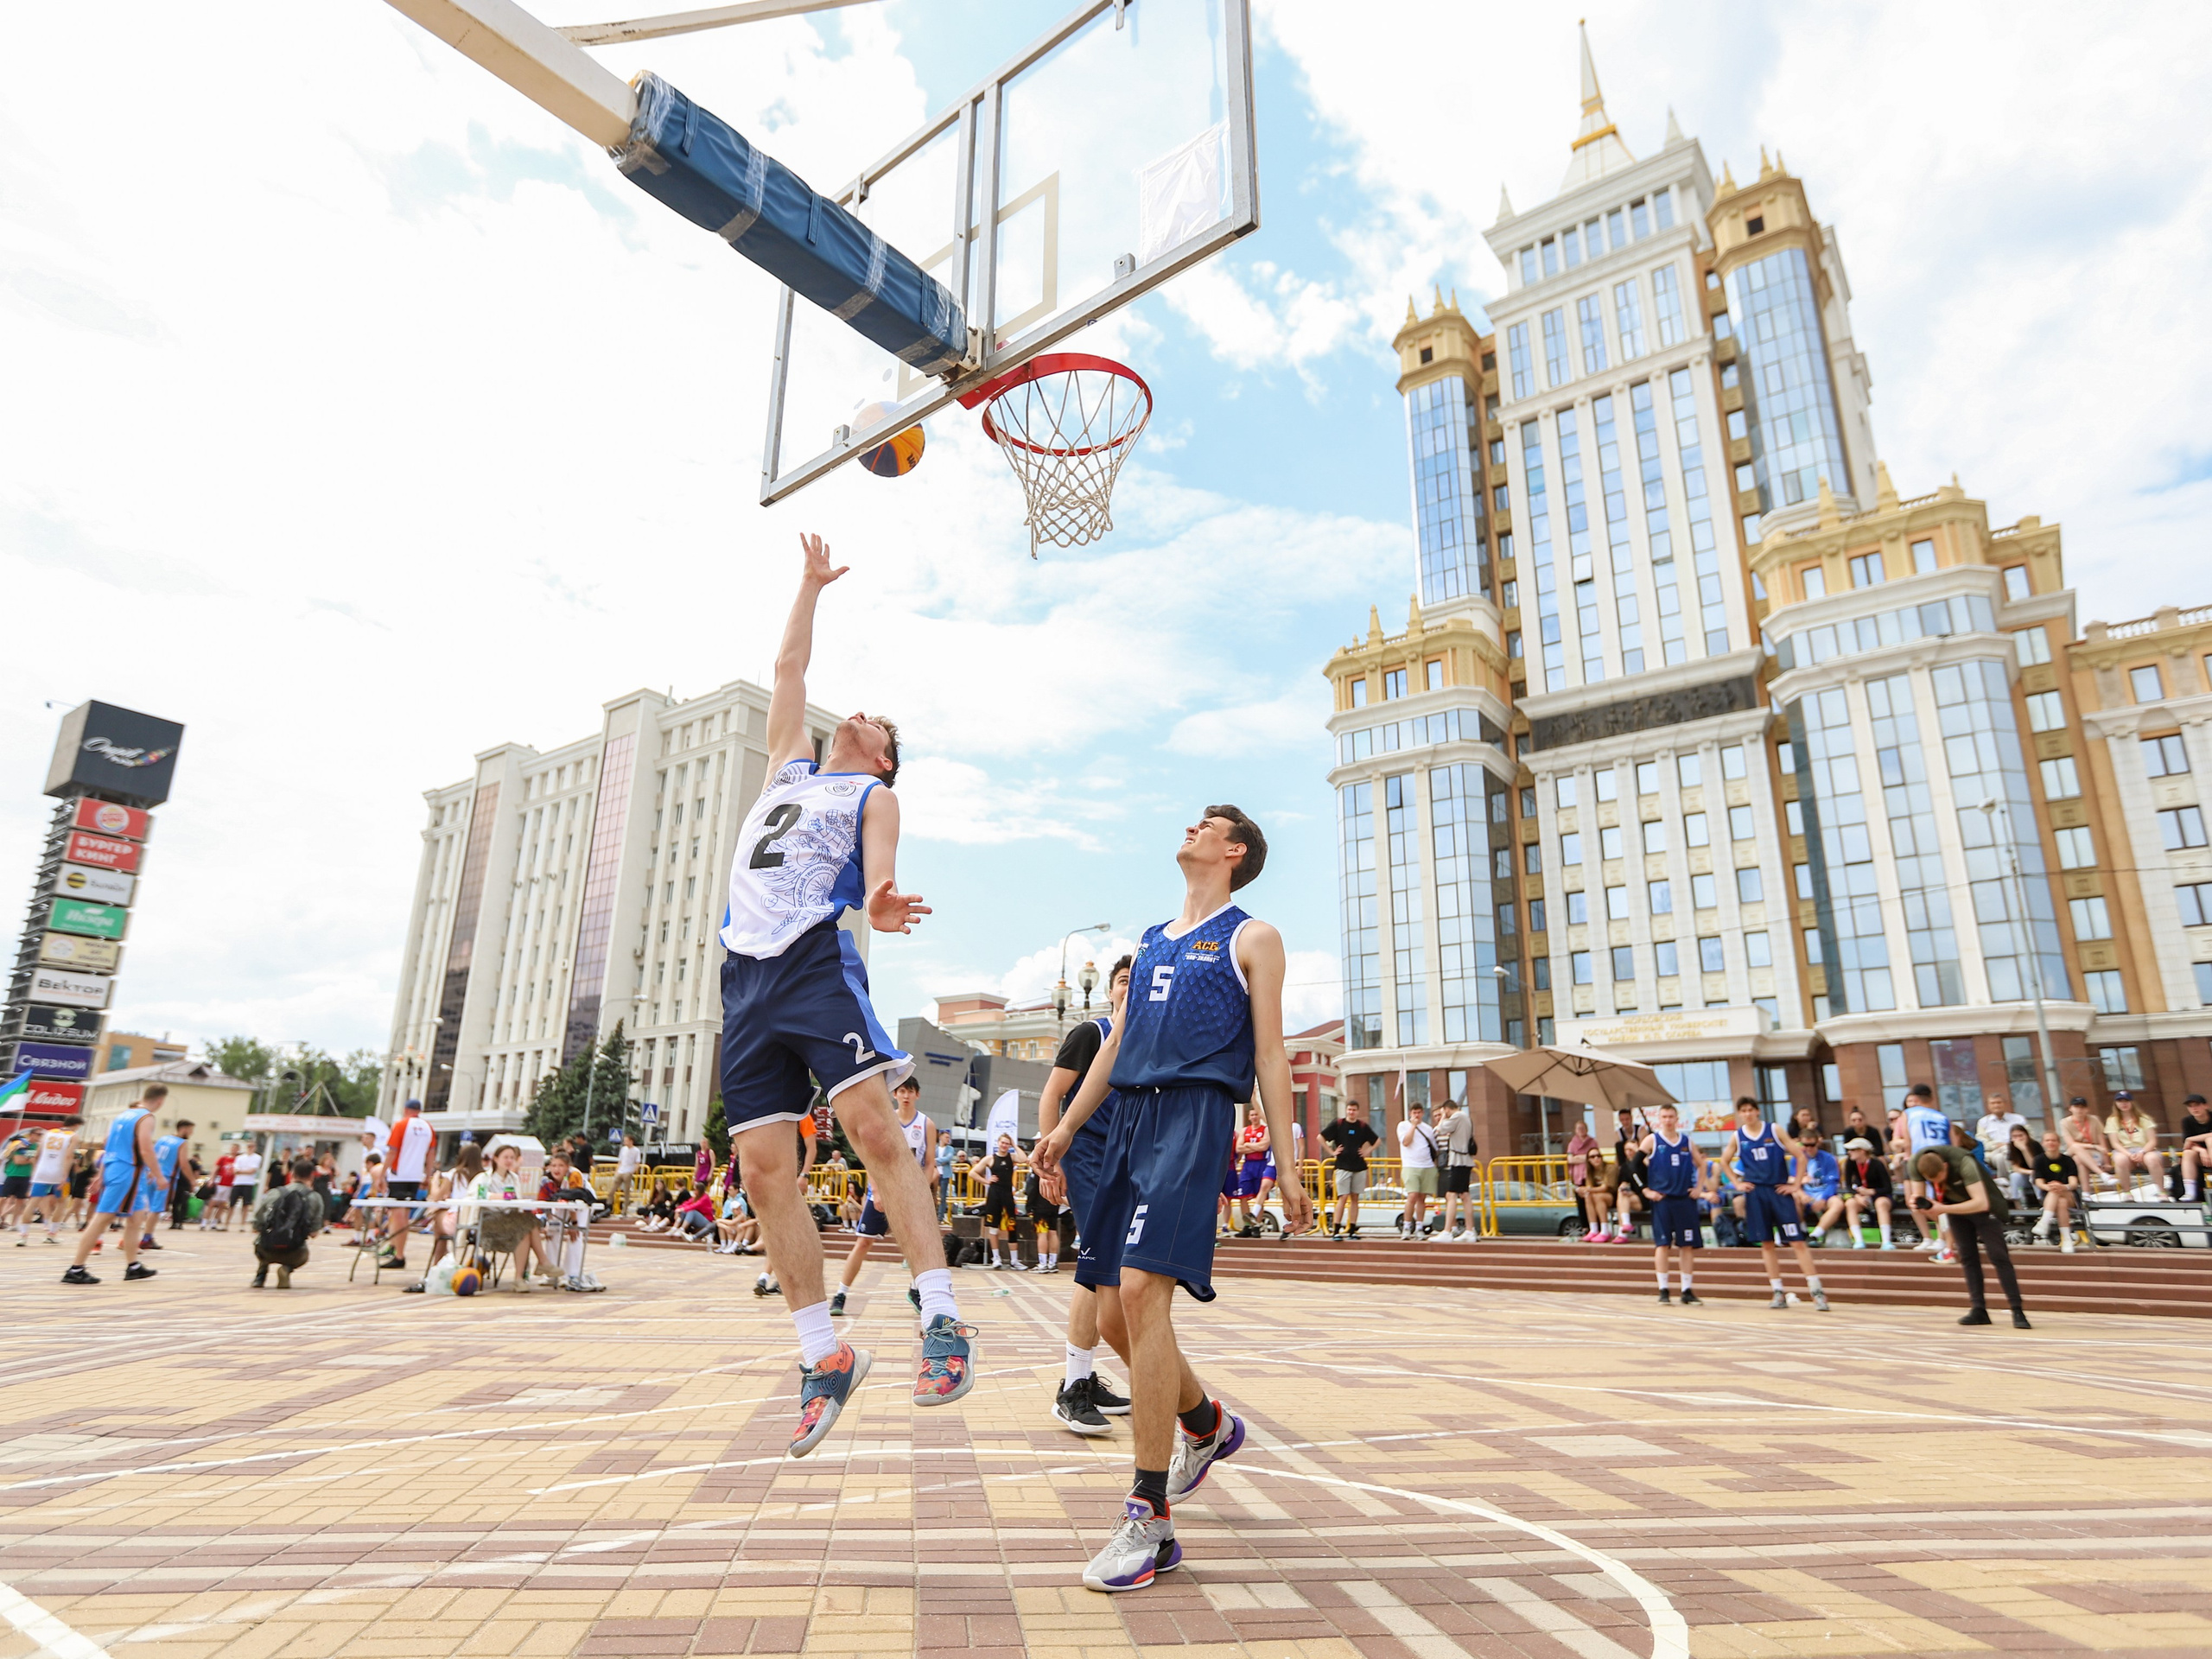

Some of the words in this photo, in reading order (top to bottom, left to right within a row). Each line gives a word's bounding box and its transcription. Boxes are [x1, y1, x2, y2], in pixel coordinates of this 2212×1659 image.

[78, 836, 133, 855] БУРГЕР
[749, 804, 803, 869] 2
[75, 848, 118, 864] КИНГ
[1148, 965, 1175, 1001] 5
[842, 1032, 876, 1065] 2
[1751, 1147, 1769, 1161] 10
[1125, 1204, 1148, 1245] 5
[1782, 1223, 1799, 1236] 10
